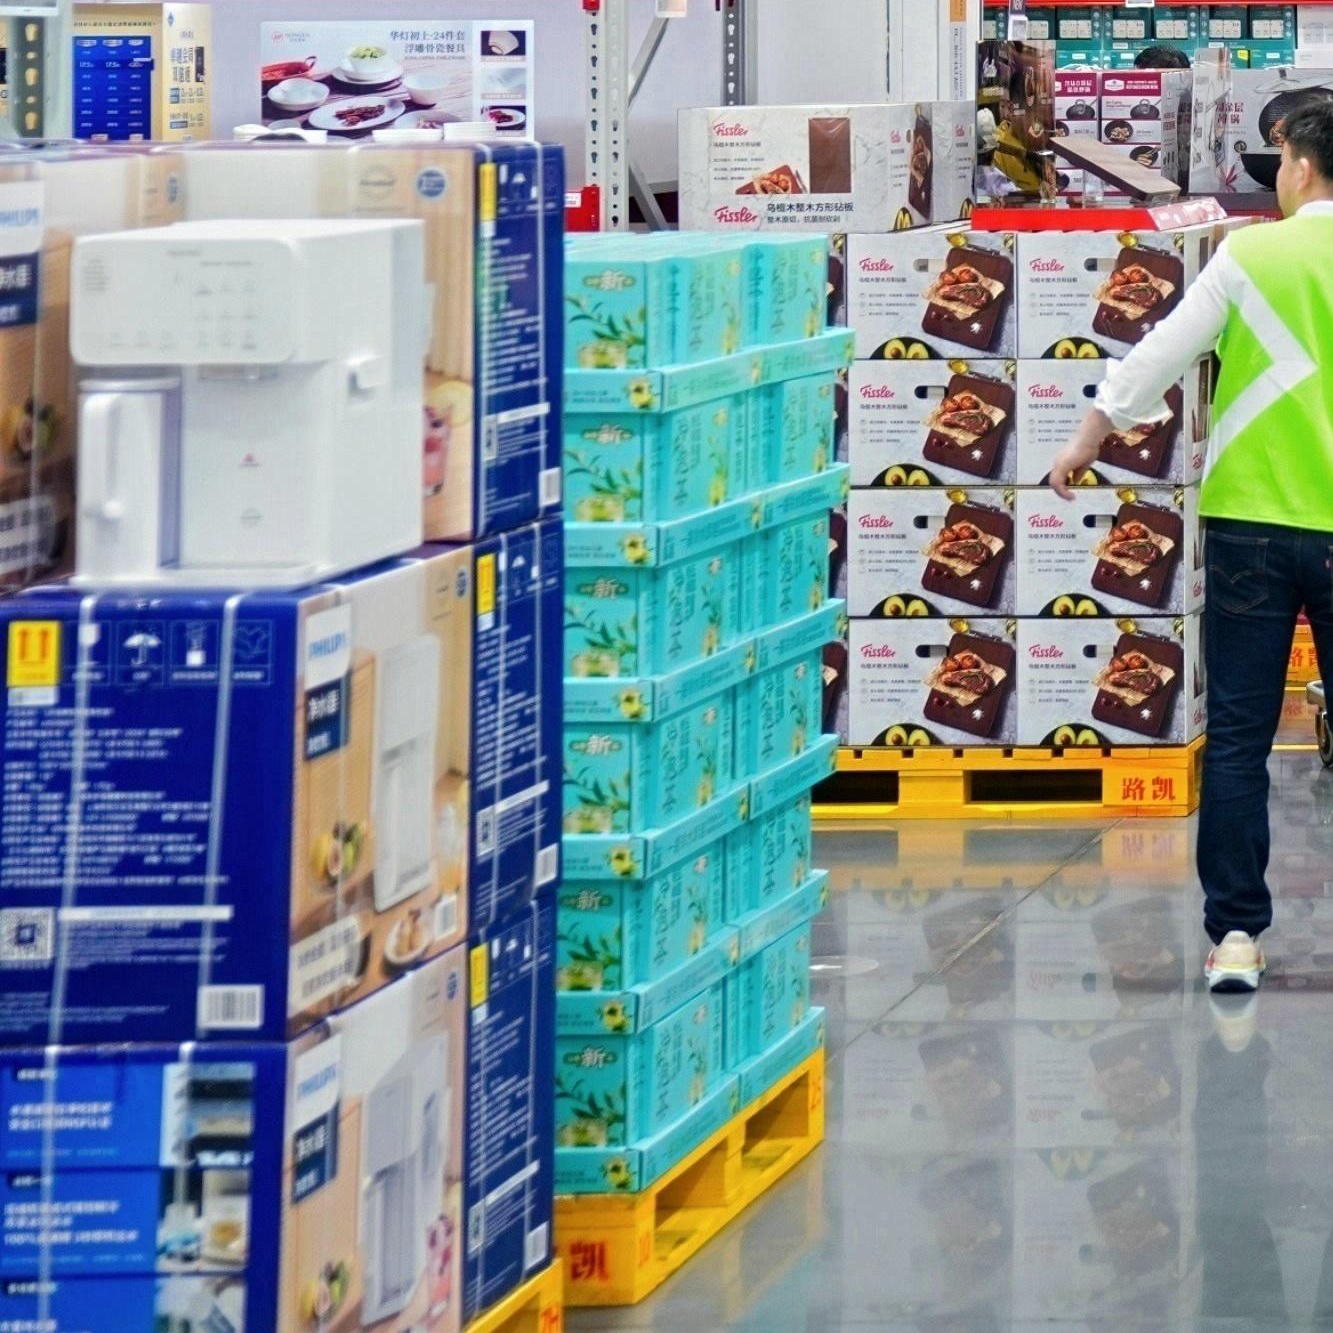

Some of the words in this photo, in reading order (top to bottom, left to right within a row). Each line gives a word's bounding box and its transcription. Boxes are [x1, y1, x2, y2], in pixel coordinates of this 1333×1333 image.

[712, 118, 749, 138] Fissler
[713, 205, 759, 224] Fissler
[859, 257, 894, 273] Fissler
[1028, 257, 1065, 273] Fissler
[859, 384, 896, 400] Fissler
[1028, 384, 1065, 400] Fissler
[859, 514, 896, 530] Fissler
[1028, 514, 1065, 530] Fissler
[860, 643, 897, 660] Fissler
[1029, 643, 1066, 660] Fissler
[1121, 776, 1176, 802] 路凯
